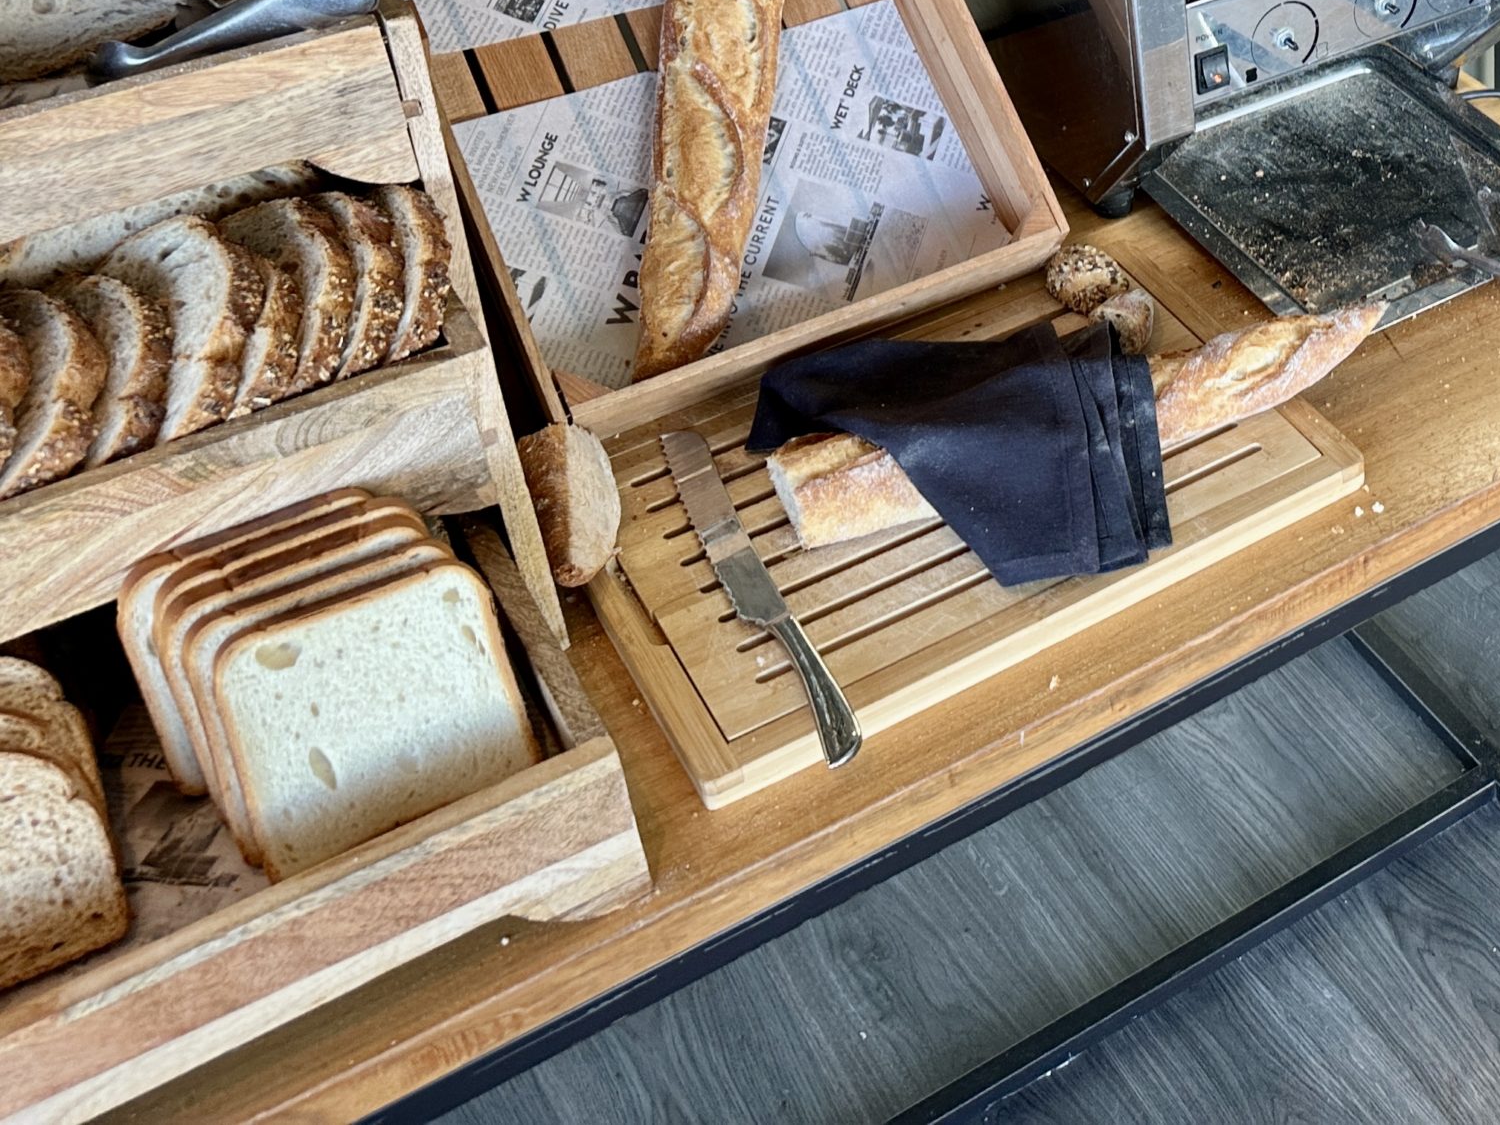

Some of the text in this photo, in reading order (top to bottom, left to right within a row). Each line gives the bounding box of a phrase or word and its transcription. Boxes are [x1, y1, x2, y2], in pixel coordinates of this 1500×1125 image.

[543, 0, 564, 30] DIVE
[830, 65, 865, 131] WET DECK
[516, 132, 558, 203] W LOUNGE
[743, 196, 780, 266] CURRENT
[605, 294, 639, 325] W
[128, 753, 167, 770] THE
